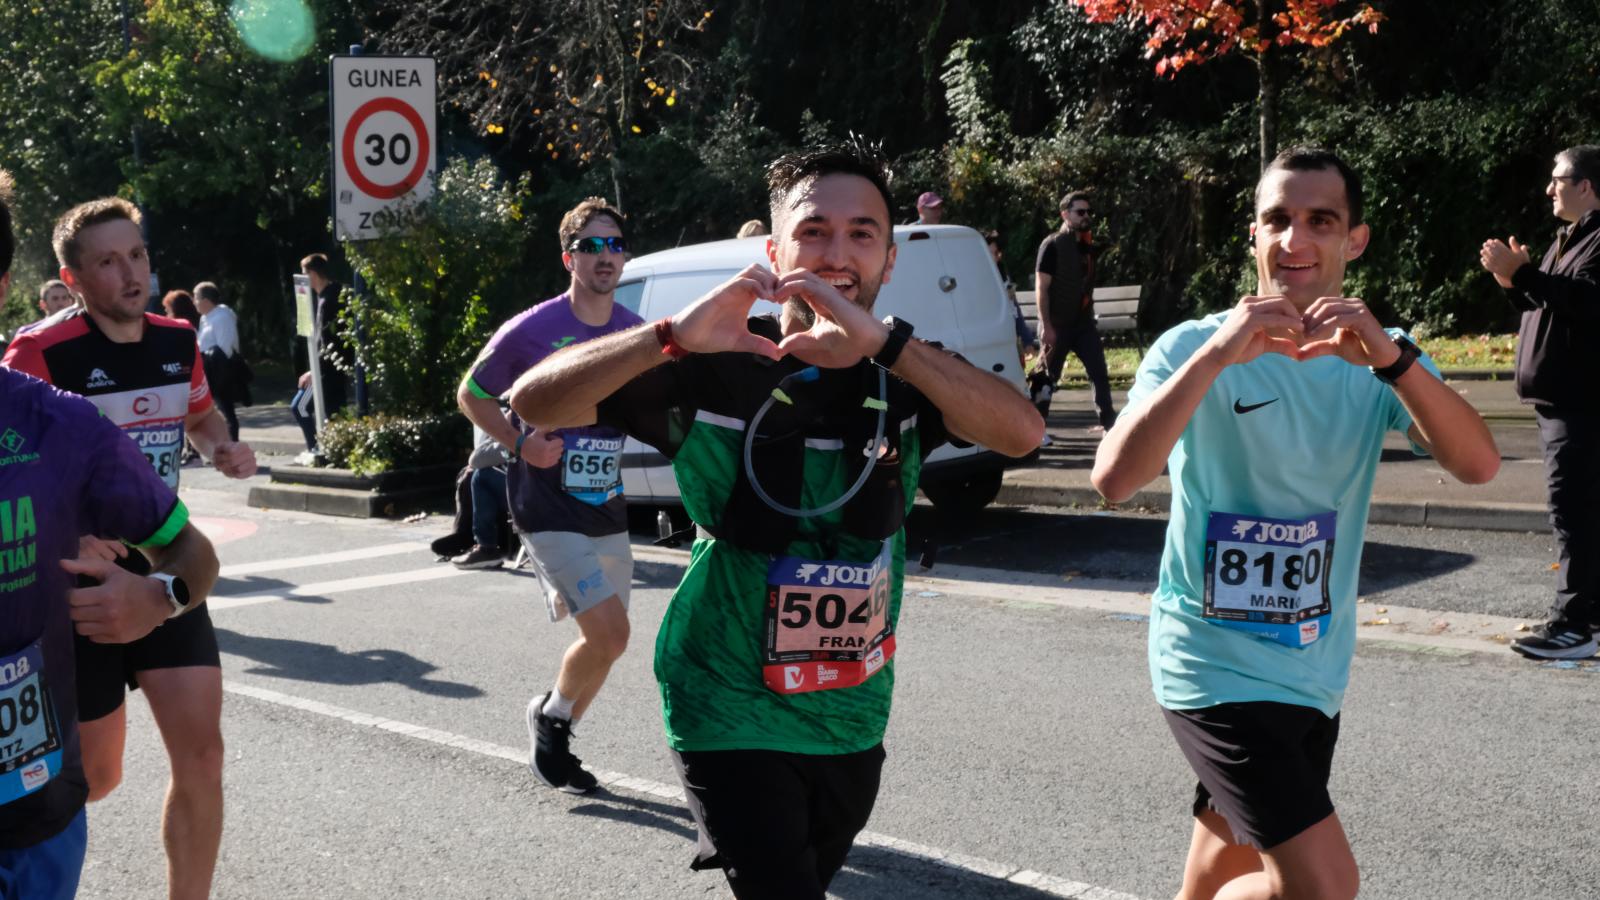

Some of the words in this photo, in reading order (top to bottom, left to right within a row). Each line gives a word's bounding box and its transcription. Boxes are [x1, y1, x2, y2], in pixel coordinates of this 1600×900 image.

[348, 69, 422, 88] GUNEA
[364, 133, 412, 167] 30
[138, 429, 180, 447] Jom
[587, 439, 621, 451] Jom
[0, 495, 37, 545] IA
[1254, 520, 1319, 544] Joma
[1219, 548, 1321, 592] 8180
[819, 636, 866, 648] FRAN
[0, 683, 40, 738] 08
